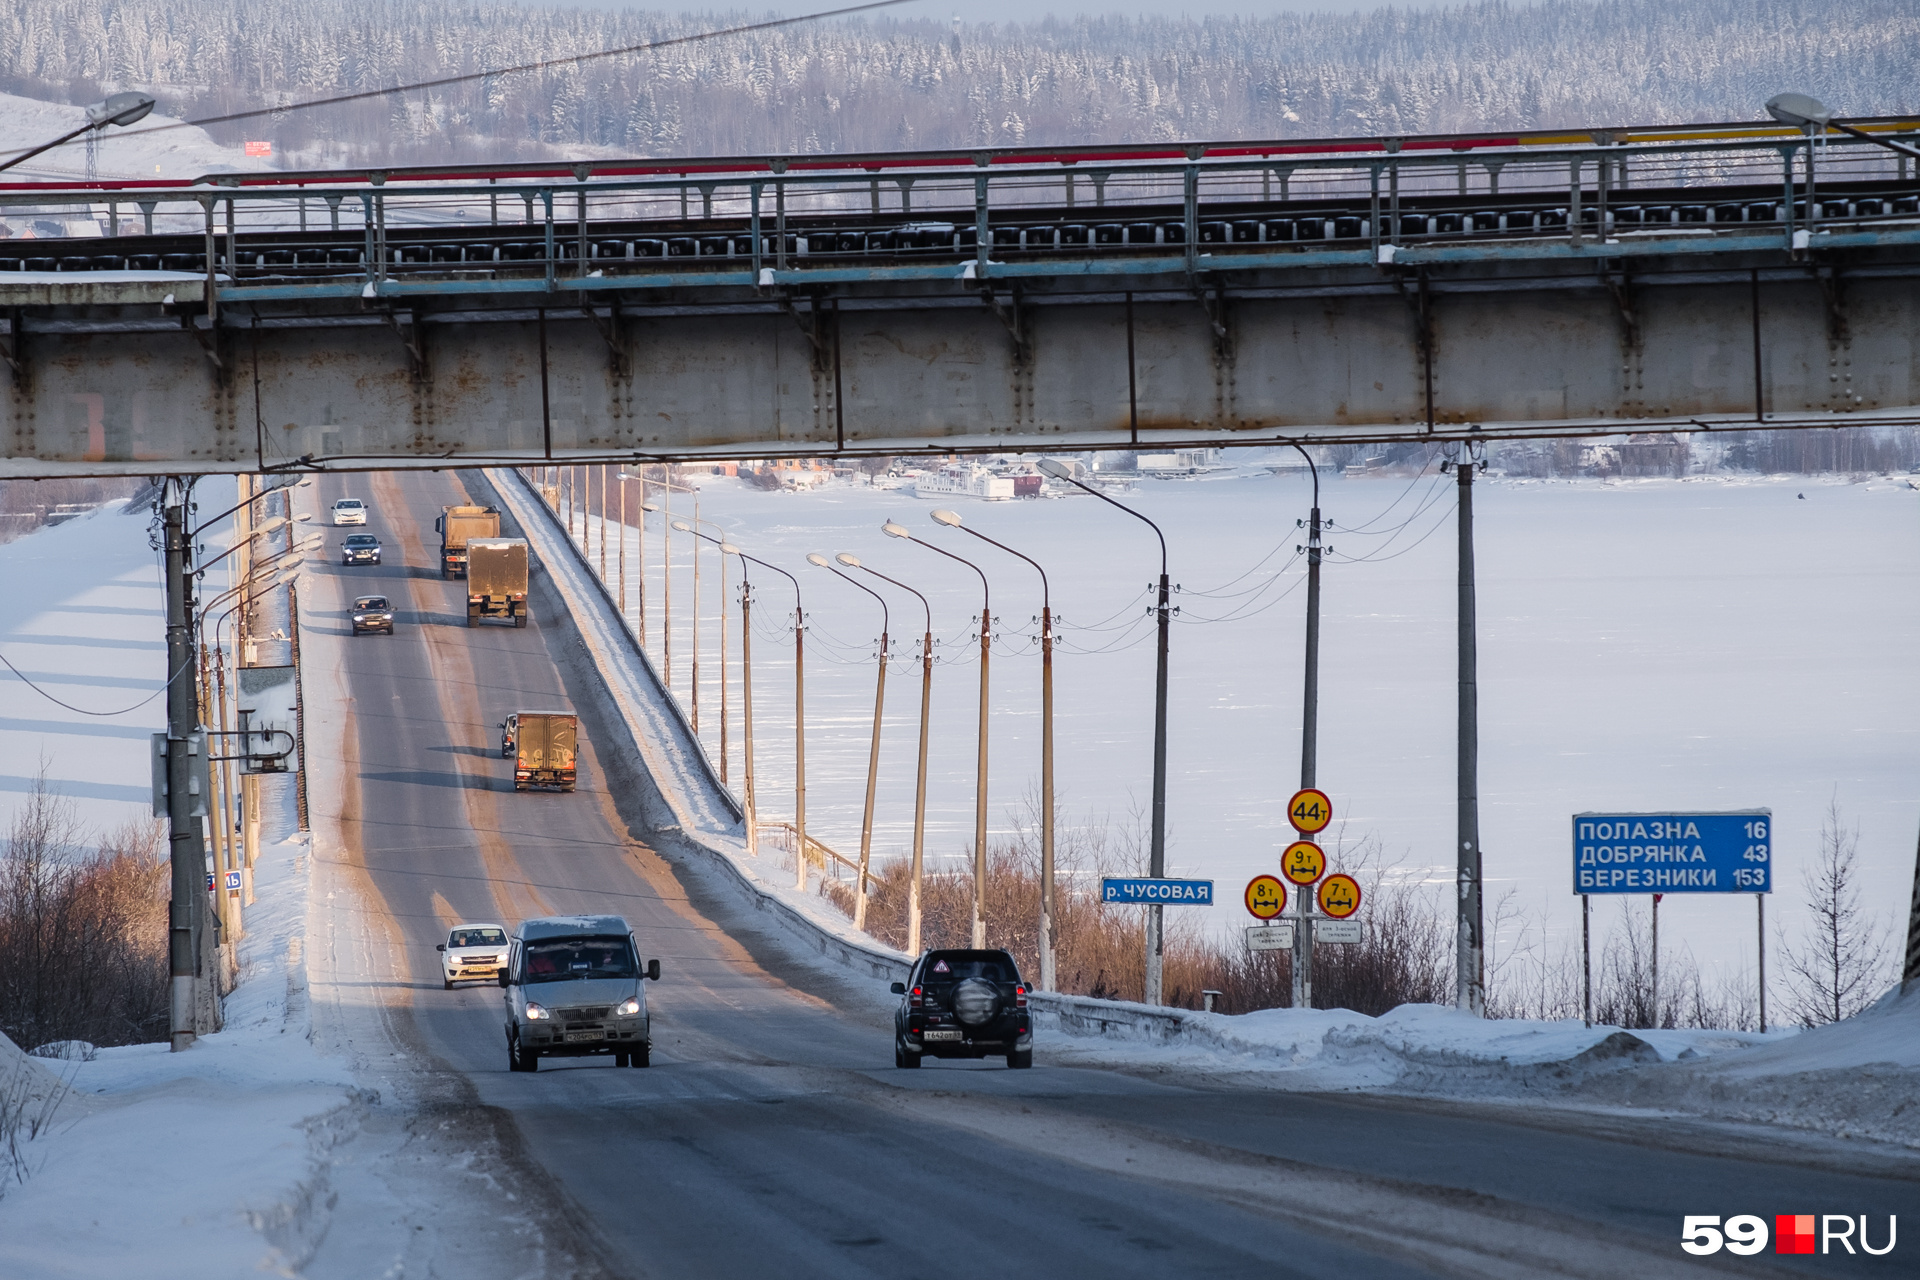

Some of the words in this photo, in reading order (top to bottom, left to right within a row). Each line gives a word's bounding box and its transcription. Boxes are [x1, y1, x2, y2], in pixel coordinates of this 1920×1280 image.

[1579, 822, 1701, 840] ПОЛАЗНА
[1744, 821, 1767, 839] 16
[1580, 845, 1707, 867] ДОБРЯНКА
[1742, 844, 1769, 863] 43
[1579, 868, 1717, 888] БЕРЕЗНИКИ
[1732, 868, 1766, 886] 153
[1106, 886, 1121, 900] р.
[1123, 884, 1209, 899] ЧУСОВАЯ
